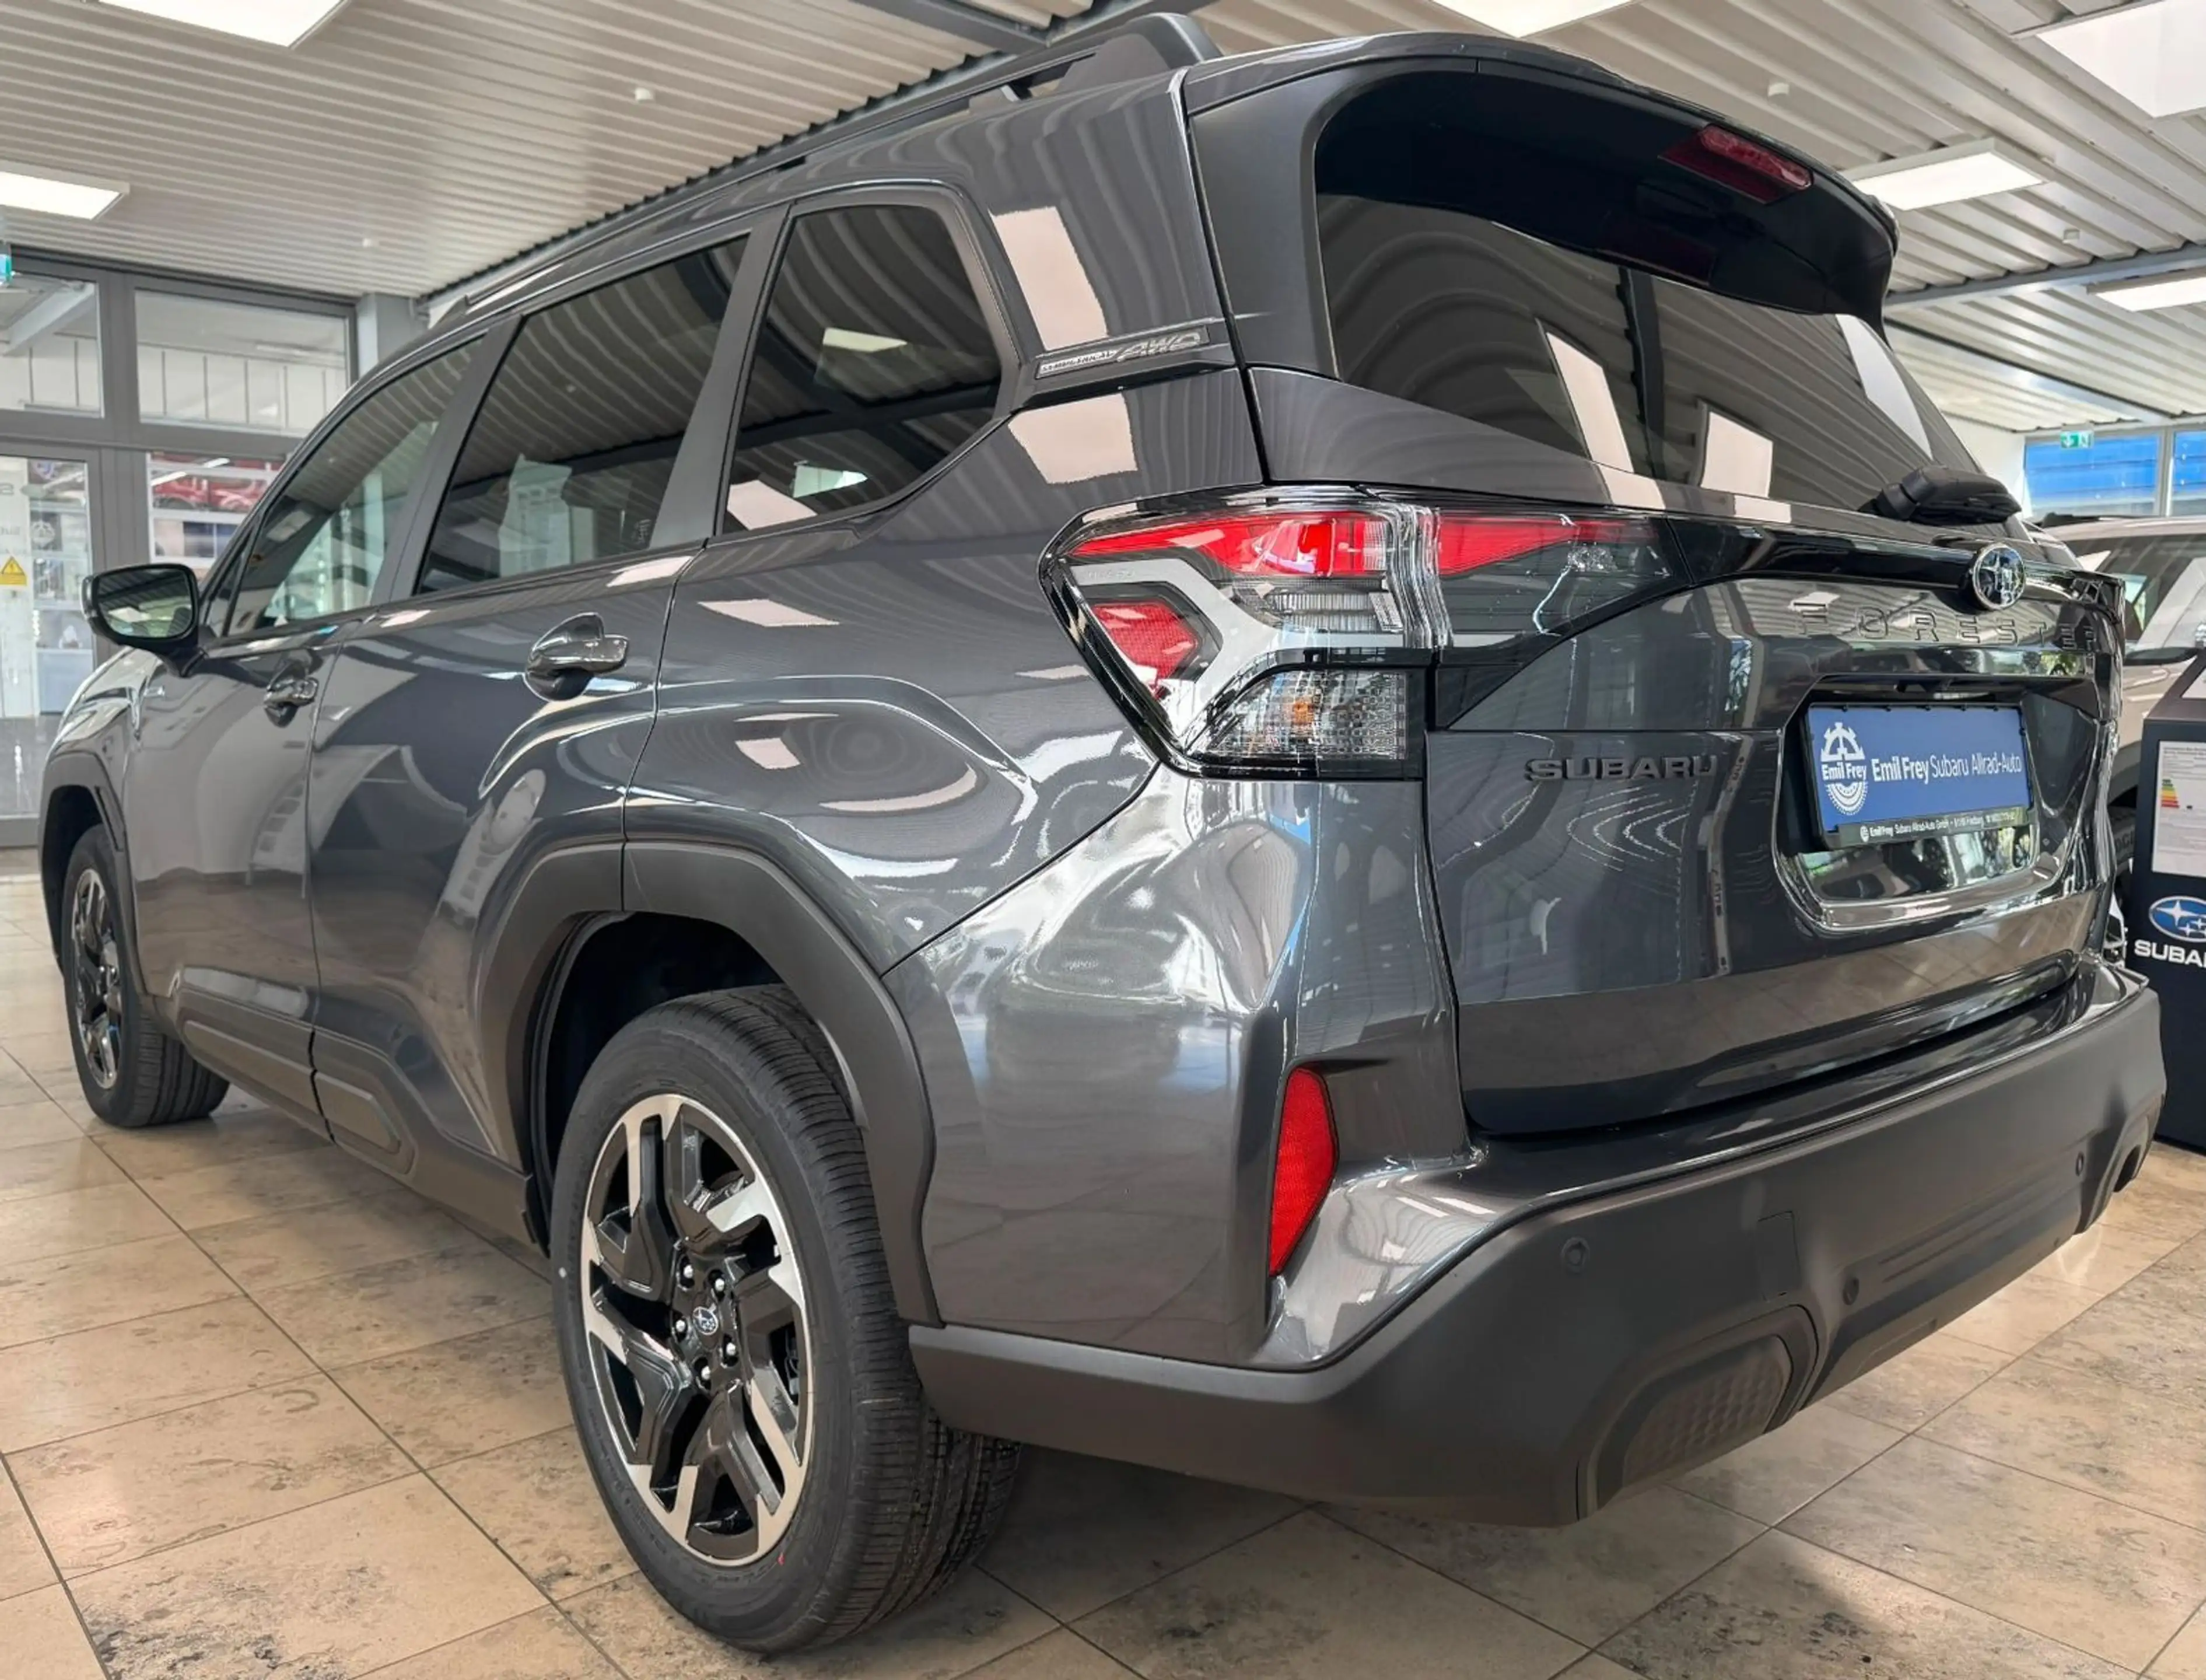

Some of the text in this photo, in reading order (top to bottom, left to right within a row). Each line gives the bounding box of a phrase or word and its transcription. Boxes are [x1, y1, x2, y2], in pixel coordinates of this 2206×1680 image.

[1792, 600, 2099, 652] FORESTER
[1525, 755, 1718, 781] SUBARU
[1821, 761, 1867, 781] Emil Frey
[1871, 751, 2023, 785] Emil Frey Subaru Allrad-Auto
[2134, 939, 2206, 968] SUBA
